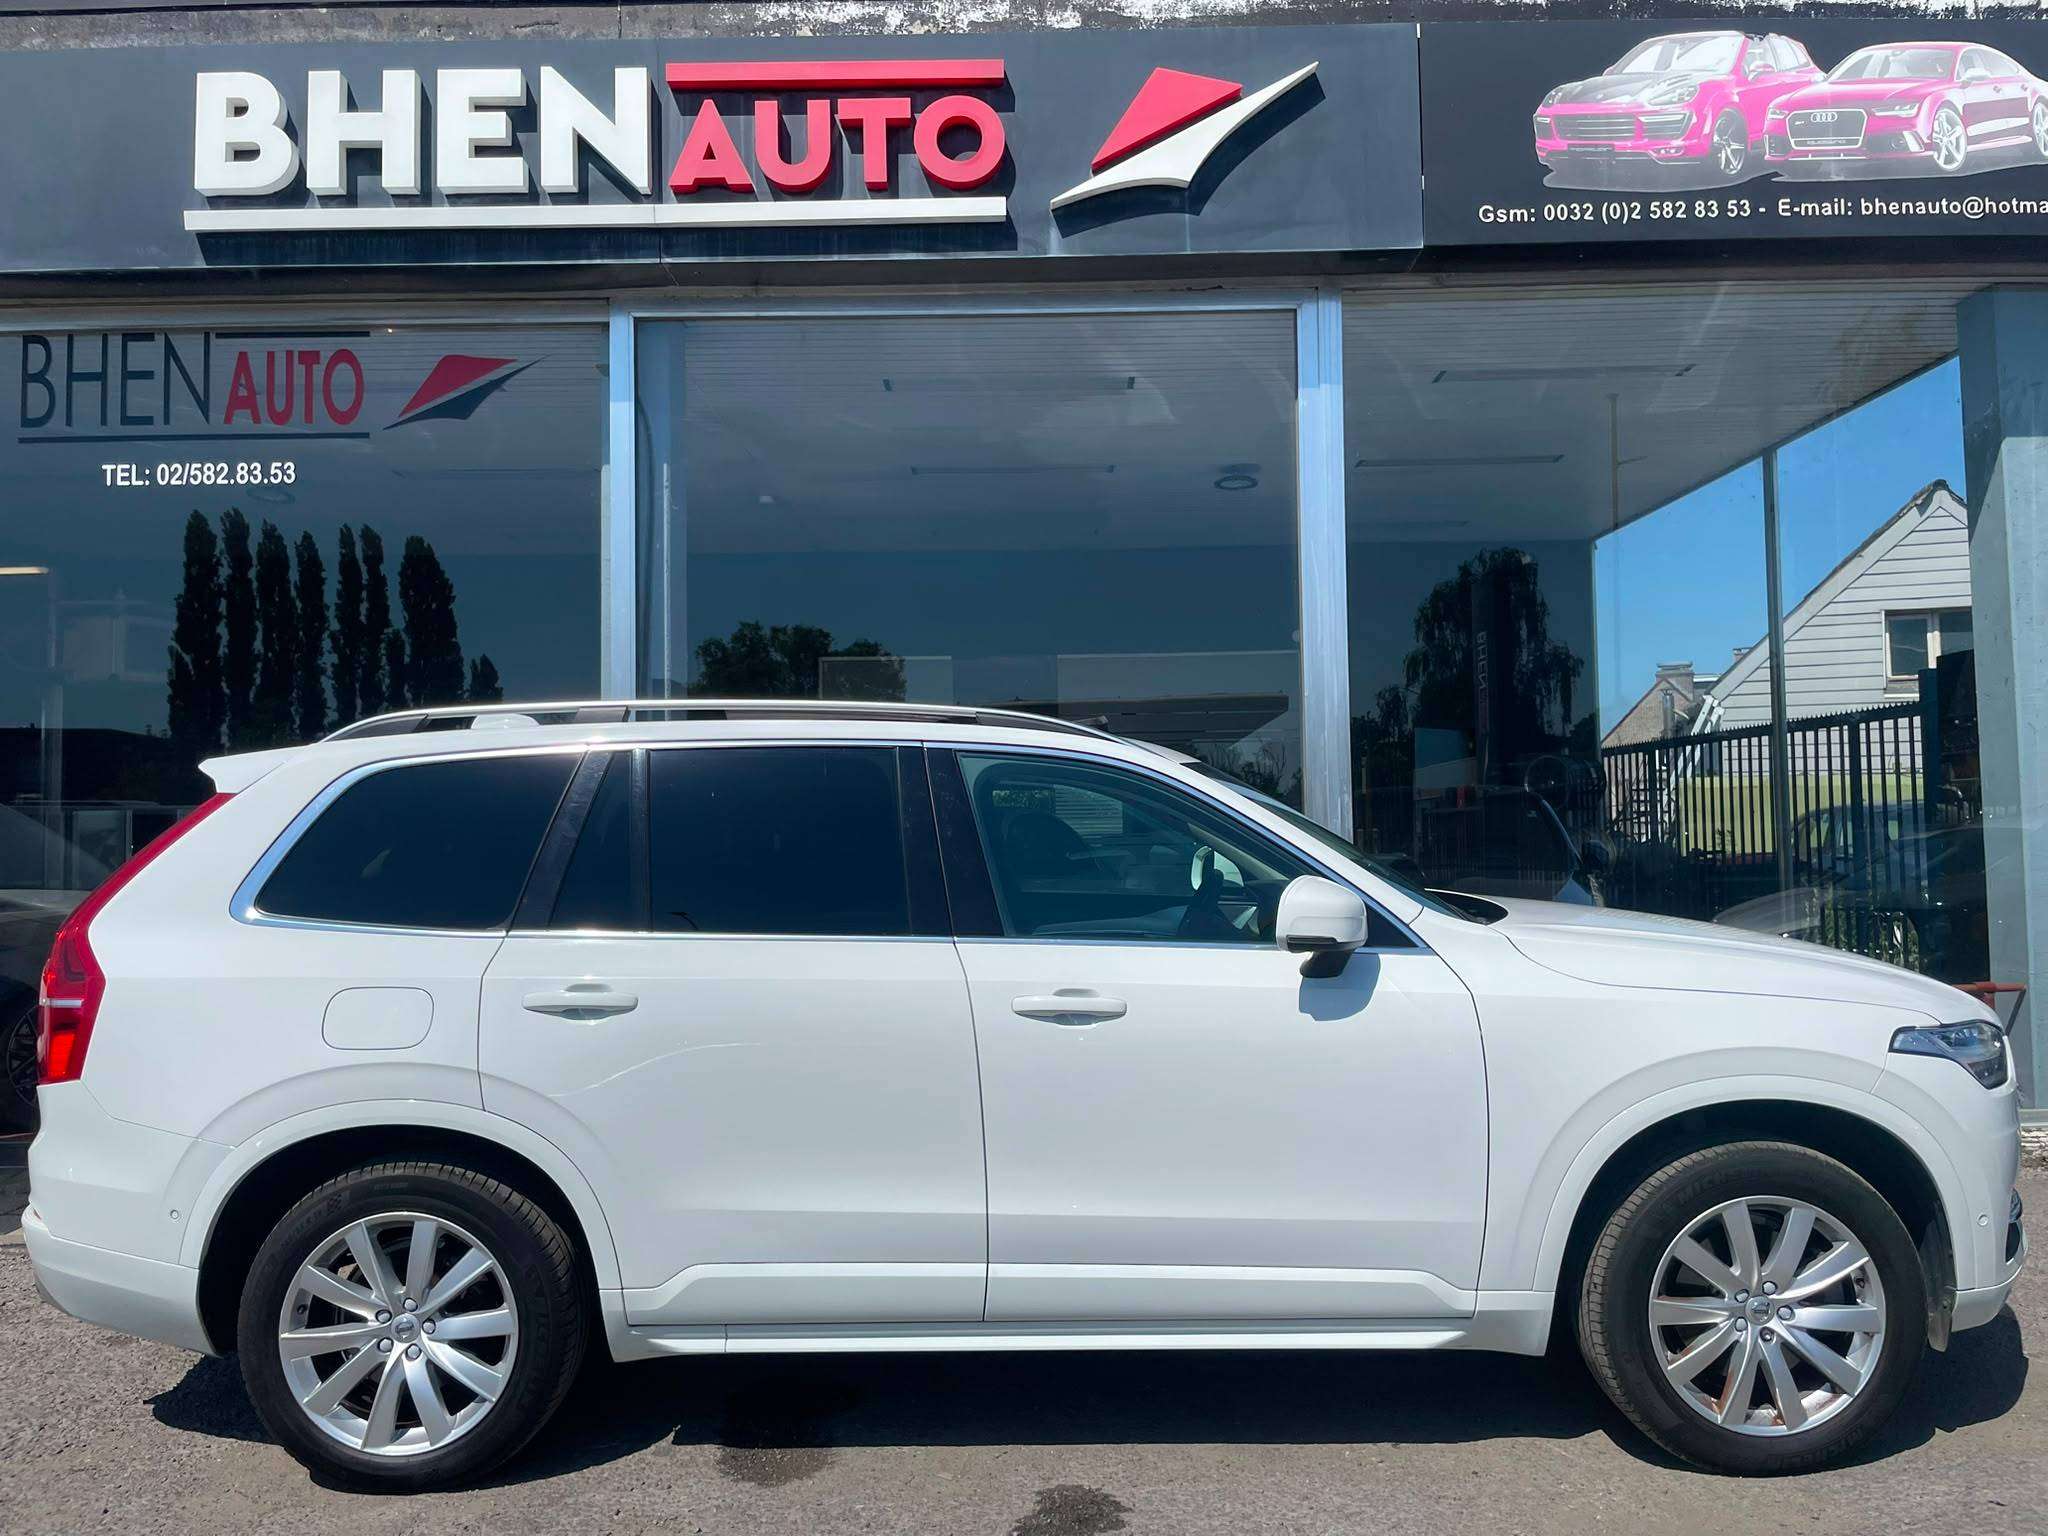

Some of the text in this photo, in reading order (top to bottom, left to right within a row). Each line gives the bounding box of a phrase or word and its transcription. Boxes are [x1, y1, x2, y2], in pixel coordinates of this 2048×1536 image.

[1478, 204, 1536, 223] Gsm:
[1543, 202, 1594, 221] 0032
[1601, 201, 1642, 225] (0)2
[1649, 200, 1687, 219] 582
[1694, 199, 1719, 218] 83
[1726, 199, 1751, 217] 53
[1779, 197, 1853, 217] E-mail:
[101, 461, 297, 487] TEL: 02/582.83.53
